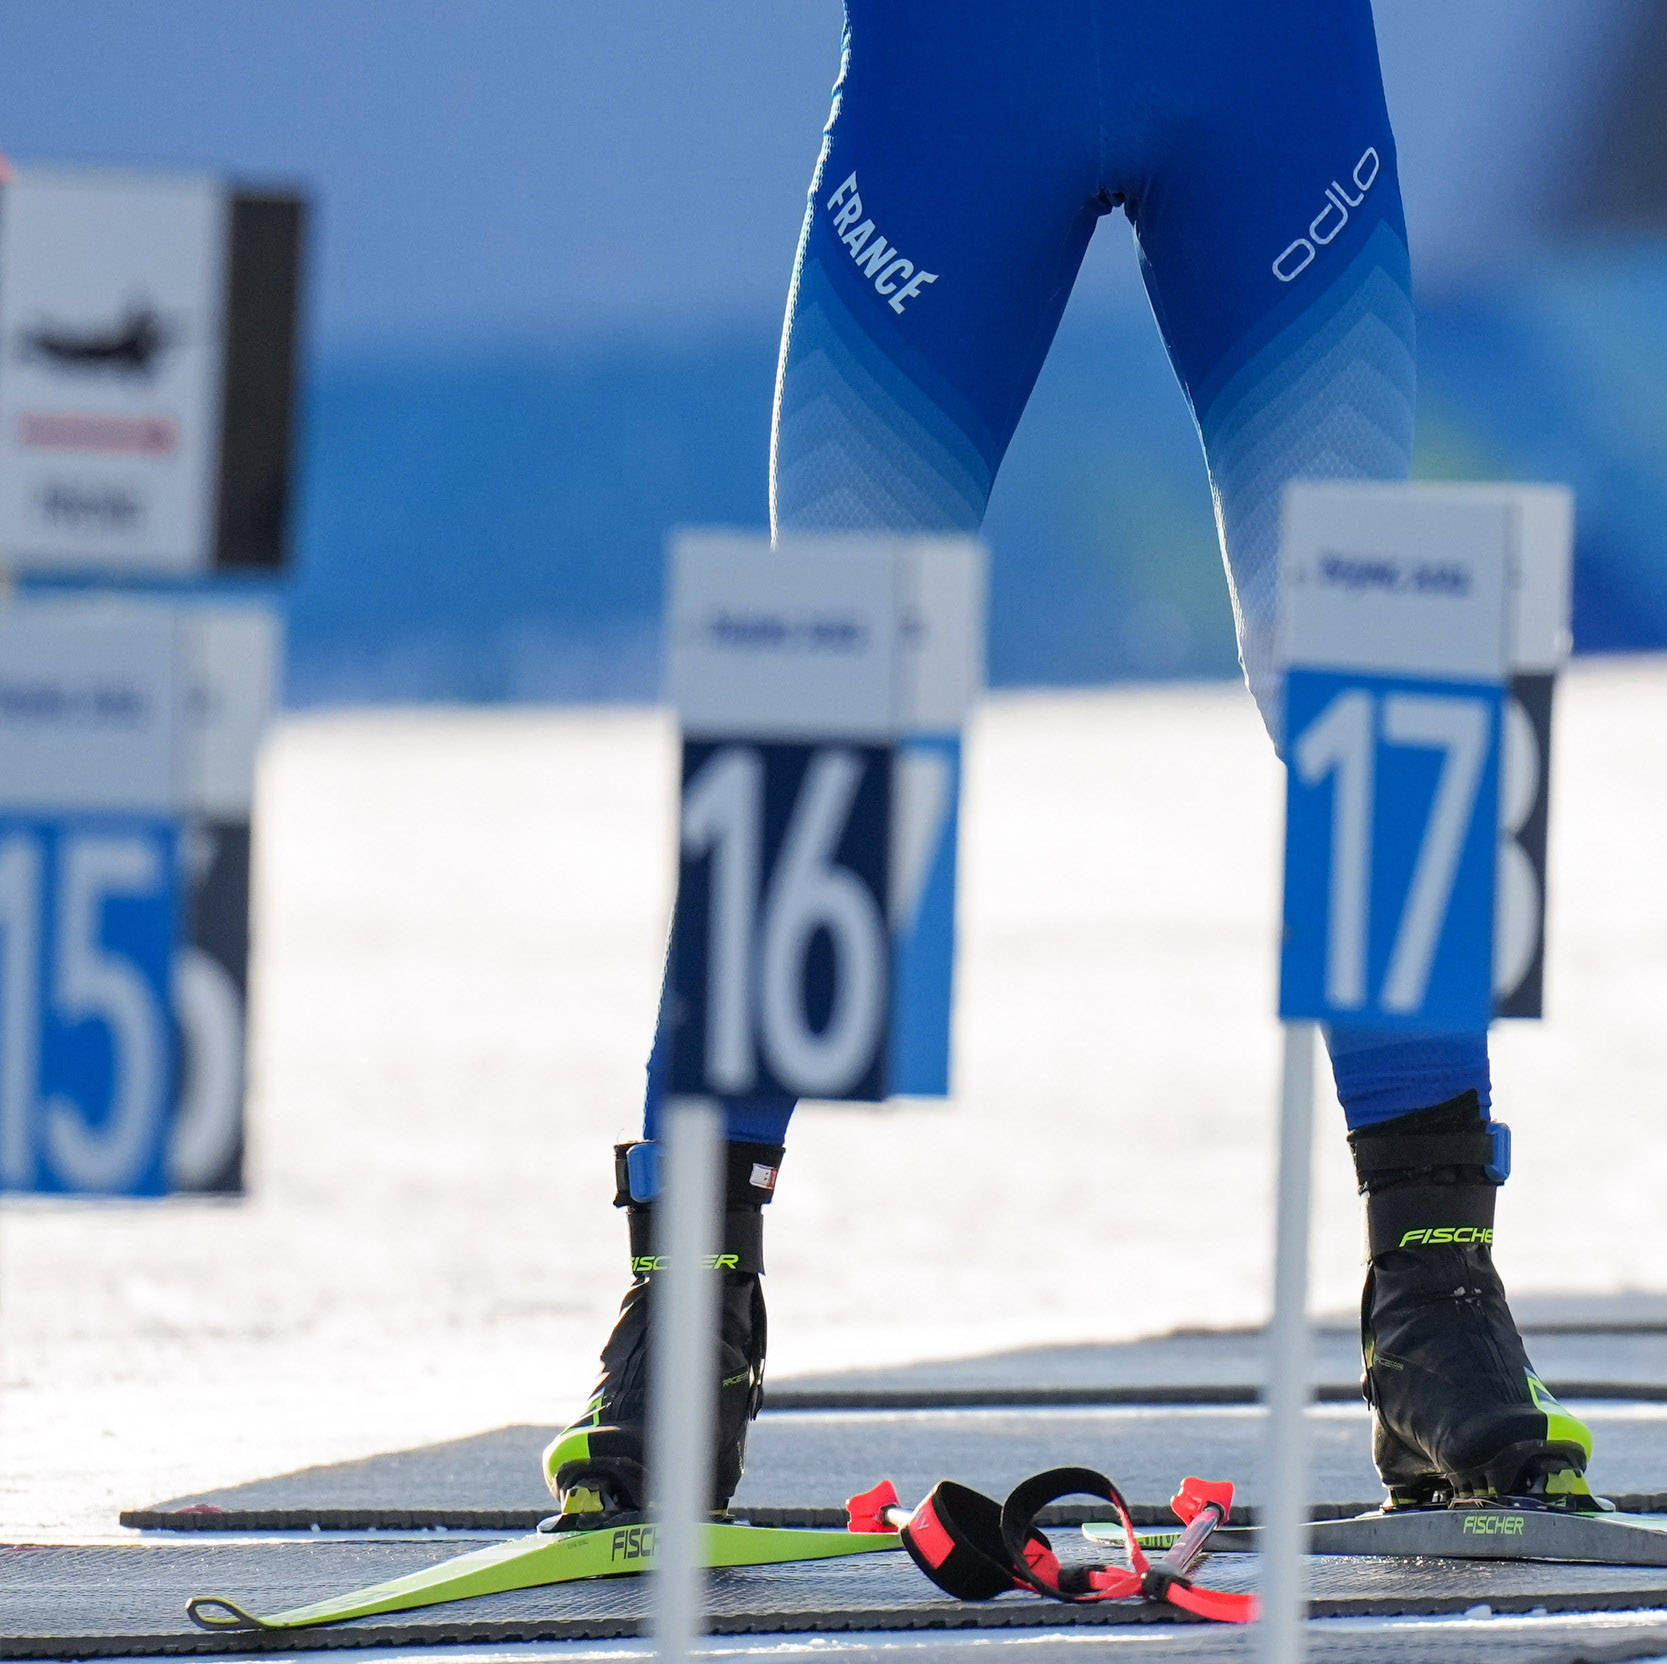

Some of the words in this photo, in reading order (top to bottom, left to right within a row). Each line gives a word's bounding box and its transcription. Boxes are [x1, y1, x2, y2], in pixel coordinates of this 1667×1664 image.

[827, 171, 939, 315] FRANCE
[1294, 688, 1492, 1015] 17
[680, 745, 890, 1096] 16
[1399, 1227, 1493, 1248] FISCHE
[612, 1527, 656, 1562] FISC
[1463, 1516, 1524, 1535] FISCHER
